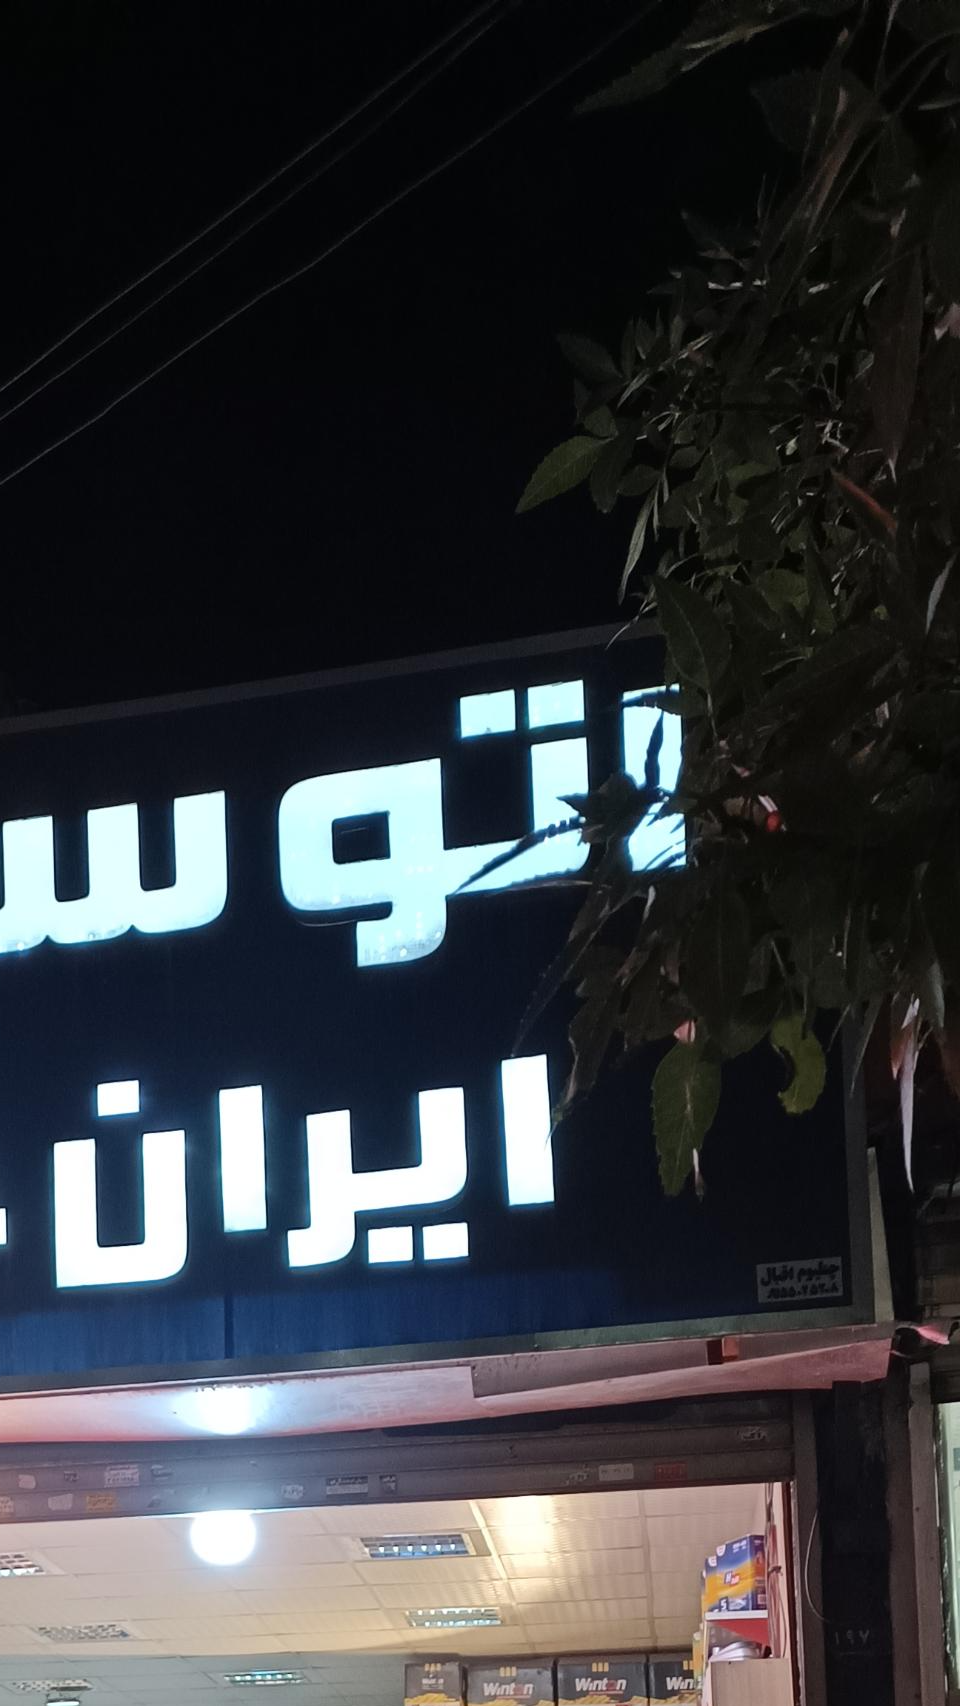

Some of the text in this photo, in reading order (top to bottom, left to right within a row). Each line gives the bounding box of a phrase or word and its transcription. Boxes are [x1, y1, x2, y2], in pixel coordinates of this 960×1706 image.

[53, 1054, 555, 1288] ایران
[483, 1682, 534, 1697] Winton
[575, 1677, 628, 1692] Winton
